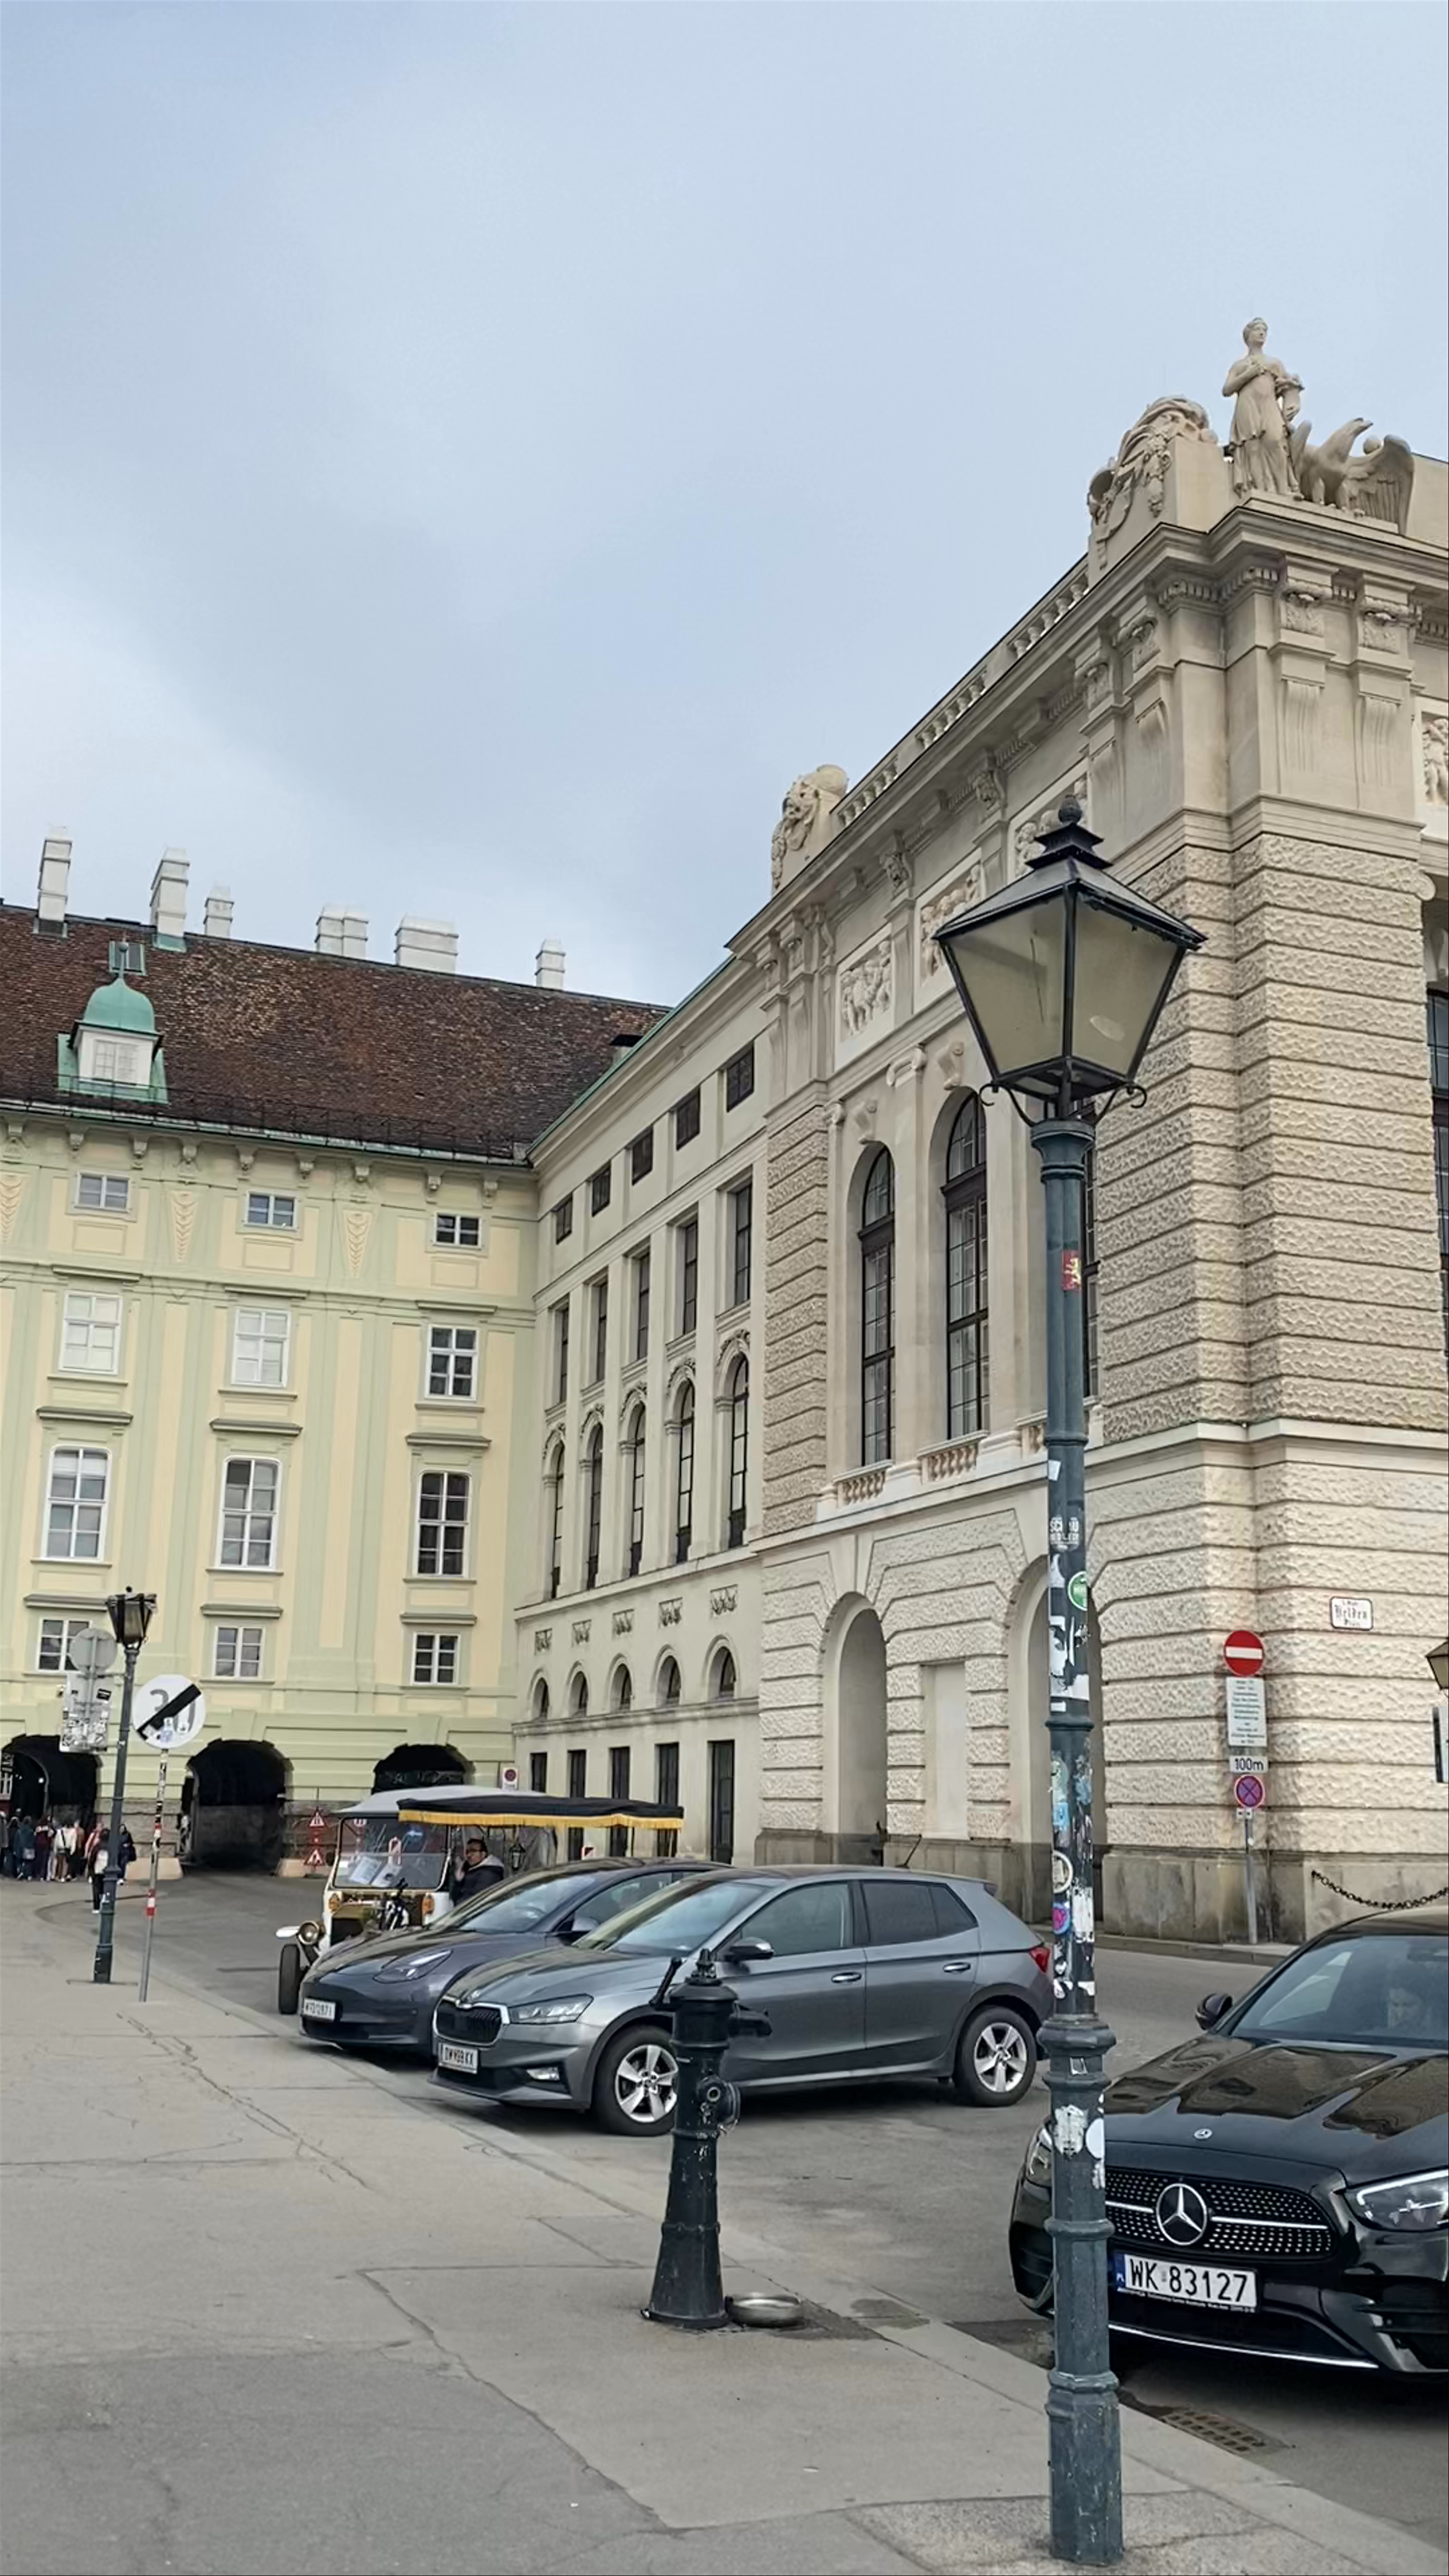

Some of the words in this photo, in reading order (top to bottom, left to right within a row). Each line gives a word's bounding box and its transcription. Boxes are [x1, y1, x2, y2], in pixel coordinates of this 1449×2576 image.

[1235, 1758, 1264, 1771] 100m
[1130, 2259, 1159, 2291] WK
[1170, 2265, 1247, 2302] 83127
